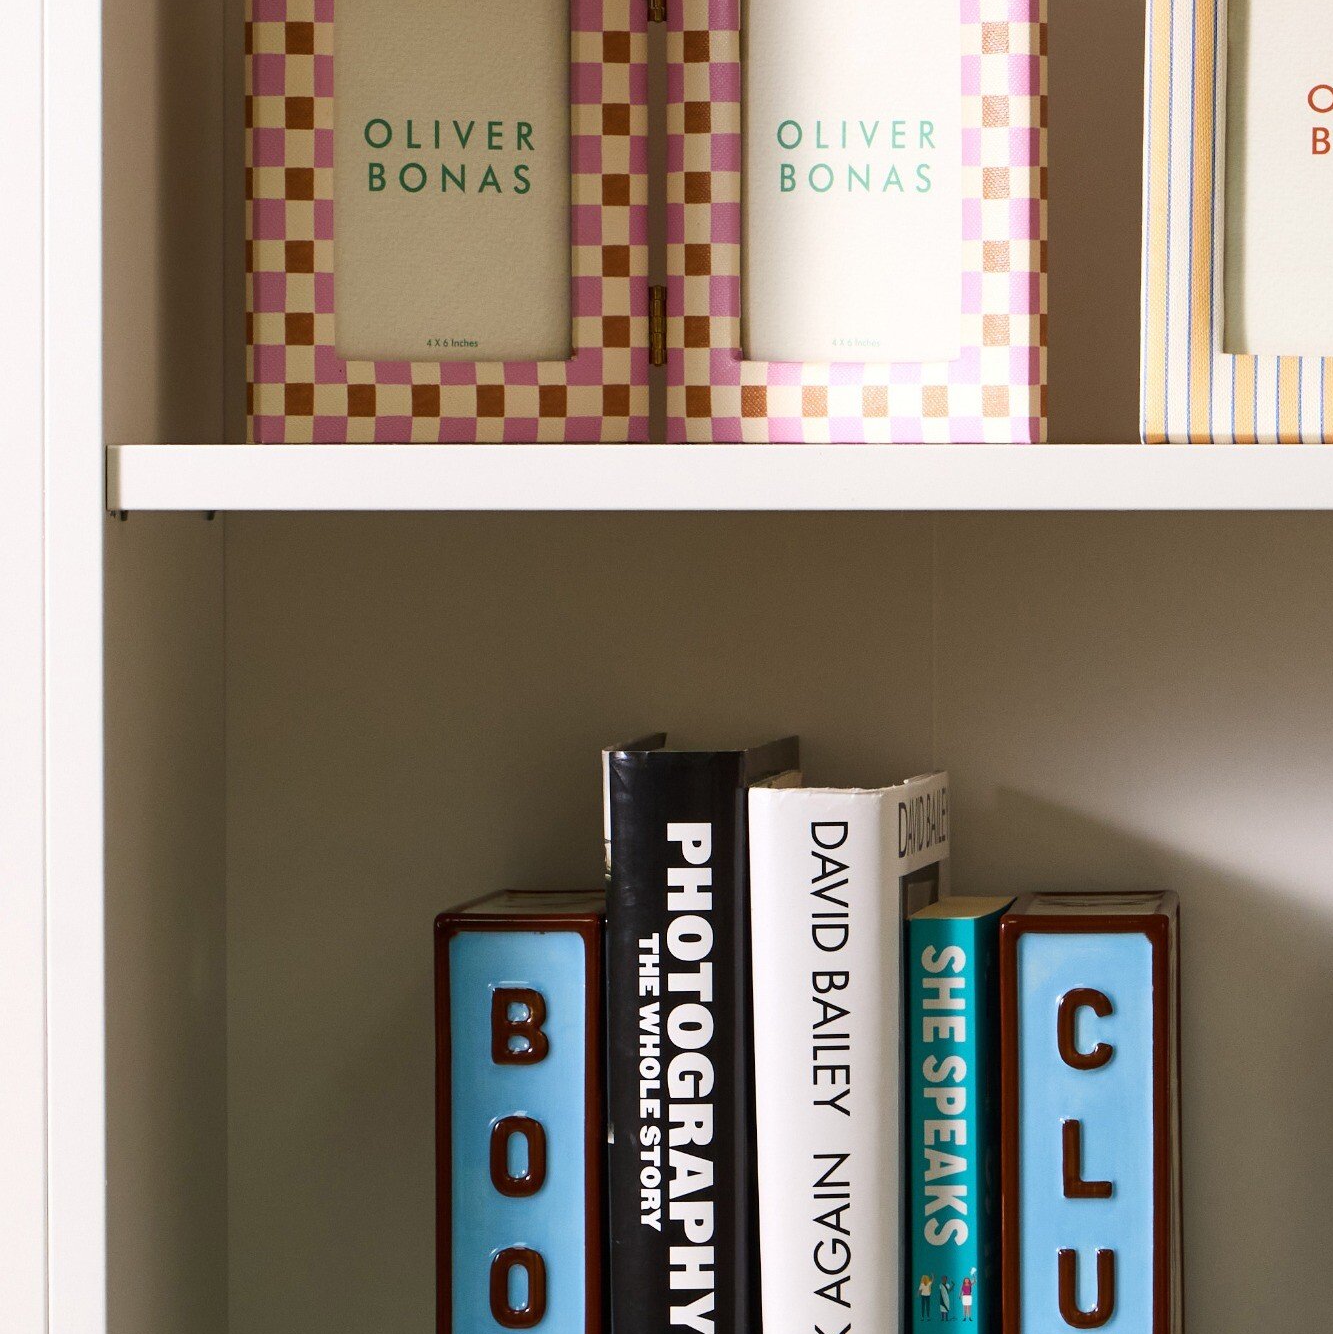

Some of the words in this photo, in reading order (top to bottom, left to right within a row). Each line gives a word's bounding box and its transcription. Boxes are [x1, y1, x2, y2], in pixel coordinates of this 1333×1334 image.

[364, 119, 535, 151] OLIVER
[368, 162, 532, 194] BONAS
[776, 119, 936, 151] OLIVER
[779, 163, 933, 194] BONAS
[451, 339, 479, 347] Inches
[810, 822, 850, 953] DAVID
[638, 934, 661, 995] THE
[921, 944, 966, 1042] SHE
[638, 999, 661, 1120] WHOLE
[812, 973, 852, 1118] BAILEY
[638, 1125, 662, 1231] STORY
[922, 1055, 968, 1248] SPEAKS
[812, 1153, 853, 1307] AGAIN
